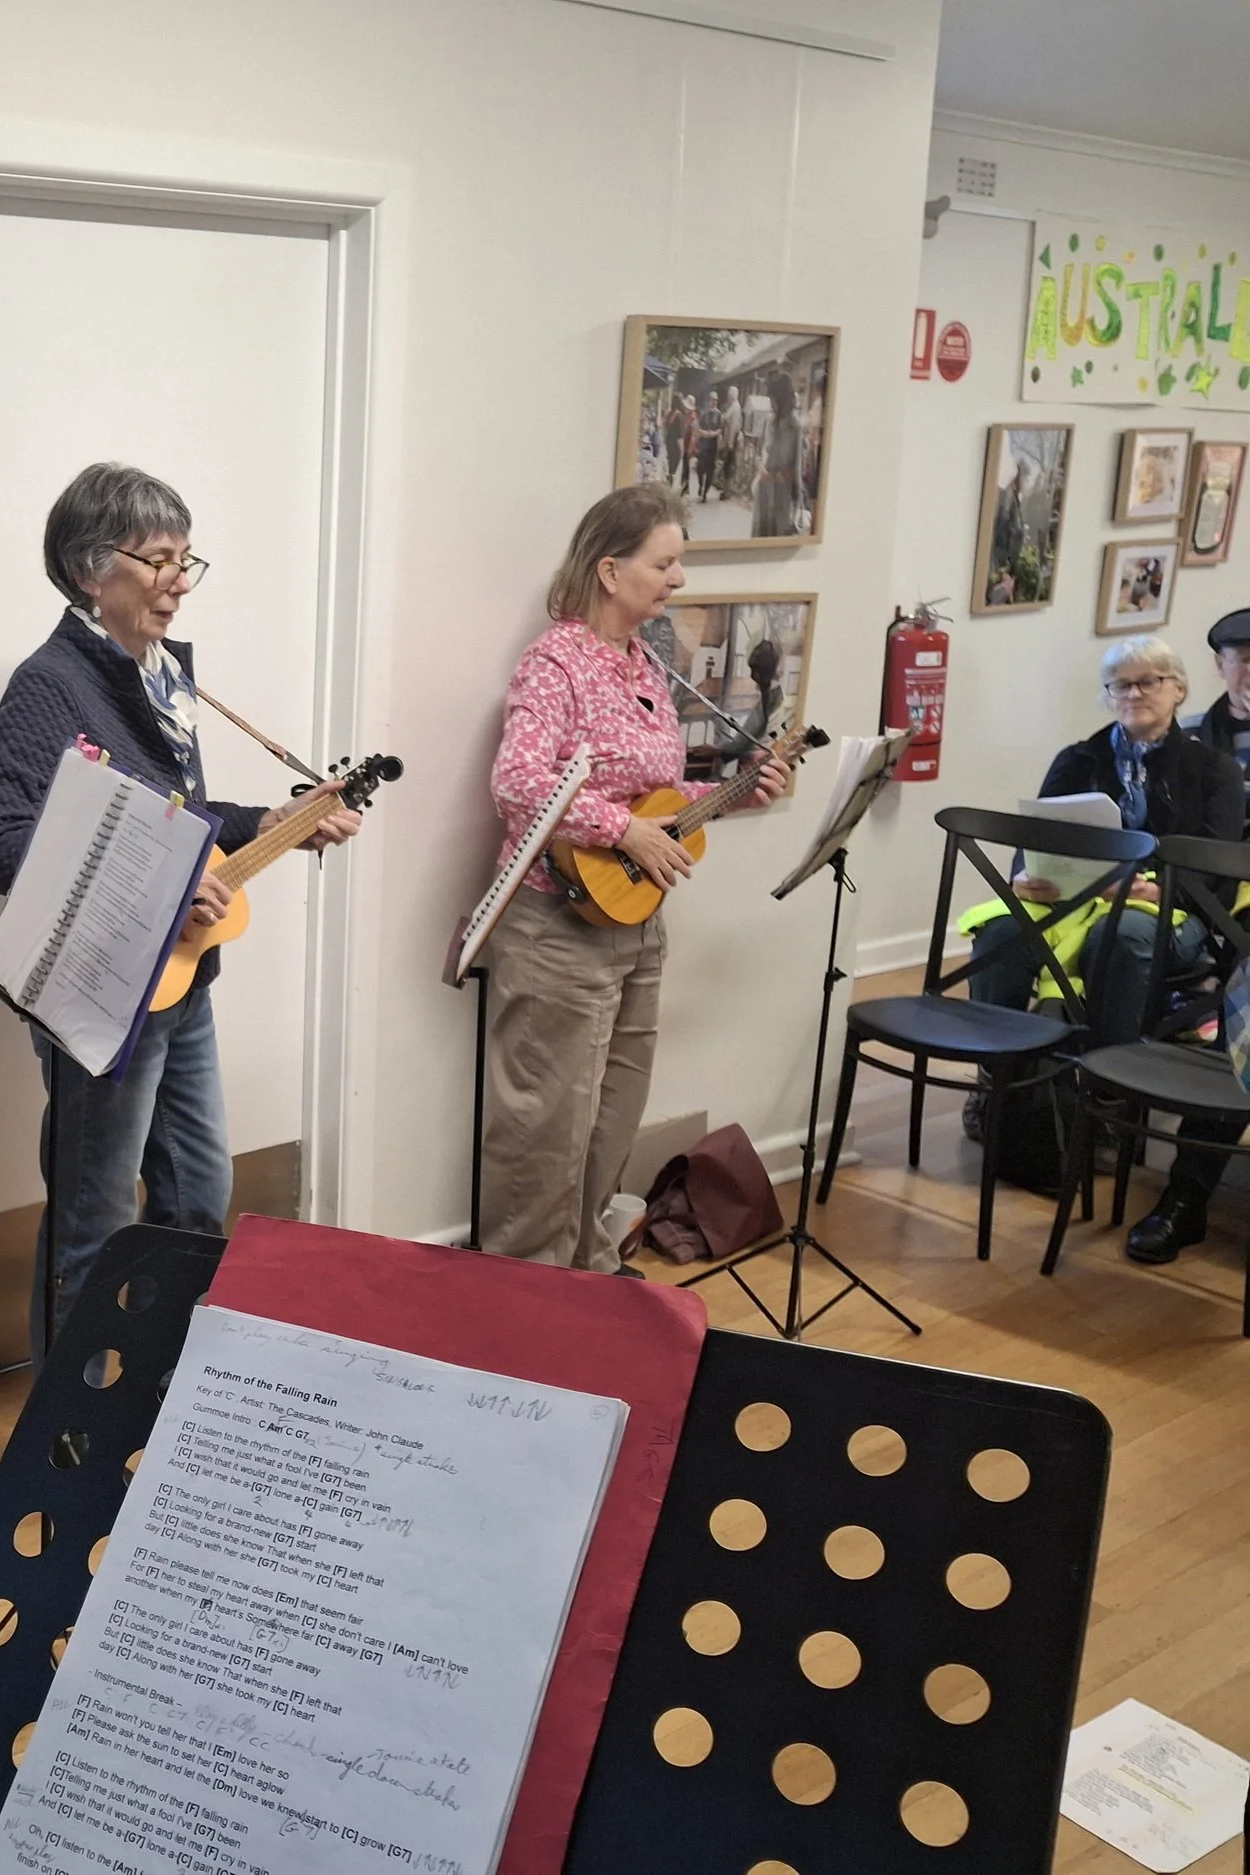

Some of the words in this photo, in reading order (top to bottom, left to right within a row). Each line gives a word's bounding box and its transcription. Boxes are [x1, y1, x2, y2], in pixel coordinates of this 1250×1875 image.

[196, 1384, 212, 1397] Key
[213, 1389, 224, 1398] of
[268, 1401, 285, 1414] The
[365, 1429, 389, 1441] John
[390, 1434, 424, 1450] Claude
[203, 1365, 242, 1383] Rhythm
[243, 1376, 256, 1386] of
[256, 1379, 273, 1391] the
[275, 1383, 311, 1403] Falling
[312, 1393, 338, 1408] Rain
[176, 1432, 192, 1445] [C]
[194, 1436, 220, 1453] Telling
[221, 1446, 236, 1456] me
[235, 1451, 253, 1461] just
[254, 1455, 276, 1467] what
[285, 1462, 302, 1474] fool
[319, 1472, 342, 1488] [G7]
[343, 1479, 367, 1492] been
[181, 1420, 197, 1433] [C]
[196, 1424, 223, 1437] Listen
[223, 1431, 233, 1442] to
[234, 1435, 249, 1446] the
[249, 1440, 280, 1454] rhythm
[281, 1448, 293, 1457] of
[292, 1451, 307, 1462] the
[307, 1455, 323, 1468] [F]
[323, 1459, 351, 1476] falling
[352, 1468, 370, 1479] rain
[258, 1419, 267, 1429] C
[285, 1427, 294, 1436] C
[295, 1429, 310, 1440] G7
[167, 1457, 186, 1470] And
[185, 1462, 201, 1476] [C]
[201, 1467, 213, 1478] let
[214, 1472, 229, 1482] me
[229, 1476, 242, 1486] be
[273, 1488, 293, 1501] lone
[318, 1502, 339, 1513] gain
[339, 1506, 363, 1522] [G7]
[177, 1446, 193, 1459] [C]
[194, 1452, 213, 1463] wish
[214, 1457, 232, 1469] that
[240, 1466, 267, 1479] would
[266, 1473, 279, 1483] go
[280, 1477, 299, 1488] and
[299, 1480, 312, 1492] let
[313, 1486, 328, 1496] me
[328, 1489, 344, 1502] [F]
[344, 1495, 360, 1506] cry
[360, 1499, 370, 1507] in
[372, 1502, 392, 1513] vain
[153, 1495, 169, 1510] [C]
[168, 1500, 203, 1520] Looking
[204, 1511, 217, 1522] for
[225, 1517, 273, 1539] brand-new
[272, 1532, 295, 1548] [G7]
[295, 1540, 317, 1553] start
[158, 1482, 173, 1496] [C]
[175, 1487, 191, 1500] The
[192, 1495, 211, 1507] only
[210, 1500, 227, 1510] girl
[232, 1507, 252, 1518] care
[253, 1513, 279, 1526] about
[280, 1520, 297, 1532] has
[297, 1524, 314, 1538] [F]
[313, 1530, 338, 1543] gone
[338, 1537, 365, 1552] away
[129, 1560, 146, 1572] For
[145, 1565, 160, 1579] [F]
[160, 1571, 177, 1582] her
[177, 1576, 186, 1586] to
[187, 1581, 210, 1593] steal
[210, 1588, 224, 1600] my
[225, 1591, 249, 1607] heart
[249, 1601, 274, 1616] away
[276, 1609, 301, 1621] when
[301, 1614, 318, 1630] [C]
[318, 1622, 337, 1634] she
[363, 1636, 386, 1649] care
[392, 1643, 420, 1662] [Am]
[447, 1660, 469, 1675] love
[133, 1546, 149, 1560] [F]
[148, 1551, 169, 1565] Rain
[169, 1560, 200, 1576] please
[201, 1569, 216, 1580] tell
[215, 1575, 231, 1585] me
[231, 1579, 251, 1591] now
[251, 1585, 274, 1599] does
[274, 1591, 300, 1608] [Em]
[300, 1599, 319, 1613] that
[319, 1606, 346, 1621] seem
[347, 1613, 365, 1625] fair
[124, 1574, 159, 1591] another
[159, 1586, 183, 1600] when
[184, 1594, 198, 1607] my
[245, 1612, 300, 1637] Somewhere
[300, 1629, 314, 1641] far
[314, 1634, 332, 1650] [C]
[332, 1642, 359, 1658] away
[359, 1648, 384, 1666] [G7]
[93, 1668, 149, 1696] Instrumental
[148, 1688, 175, 1706] Break
[76, 1693, 92, 1709] [F]
[92, 1699, 113, 1715] Rain
[138, 1719, 156, 1731] you
[157, 1724, 172, 1736] tell
[171, 1729, 188, 1742] her
[188, 1736, 207, 1750] that
[212, 1744, 237, 1763] [Em]
[237, 1753, 258, 1769] love
[259, 1761, 276, 1774] her
[277, 1769, 290, 1780] so
